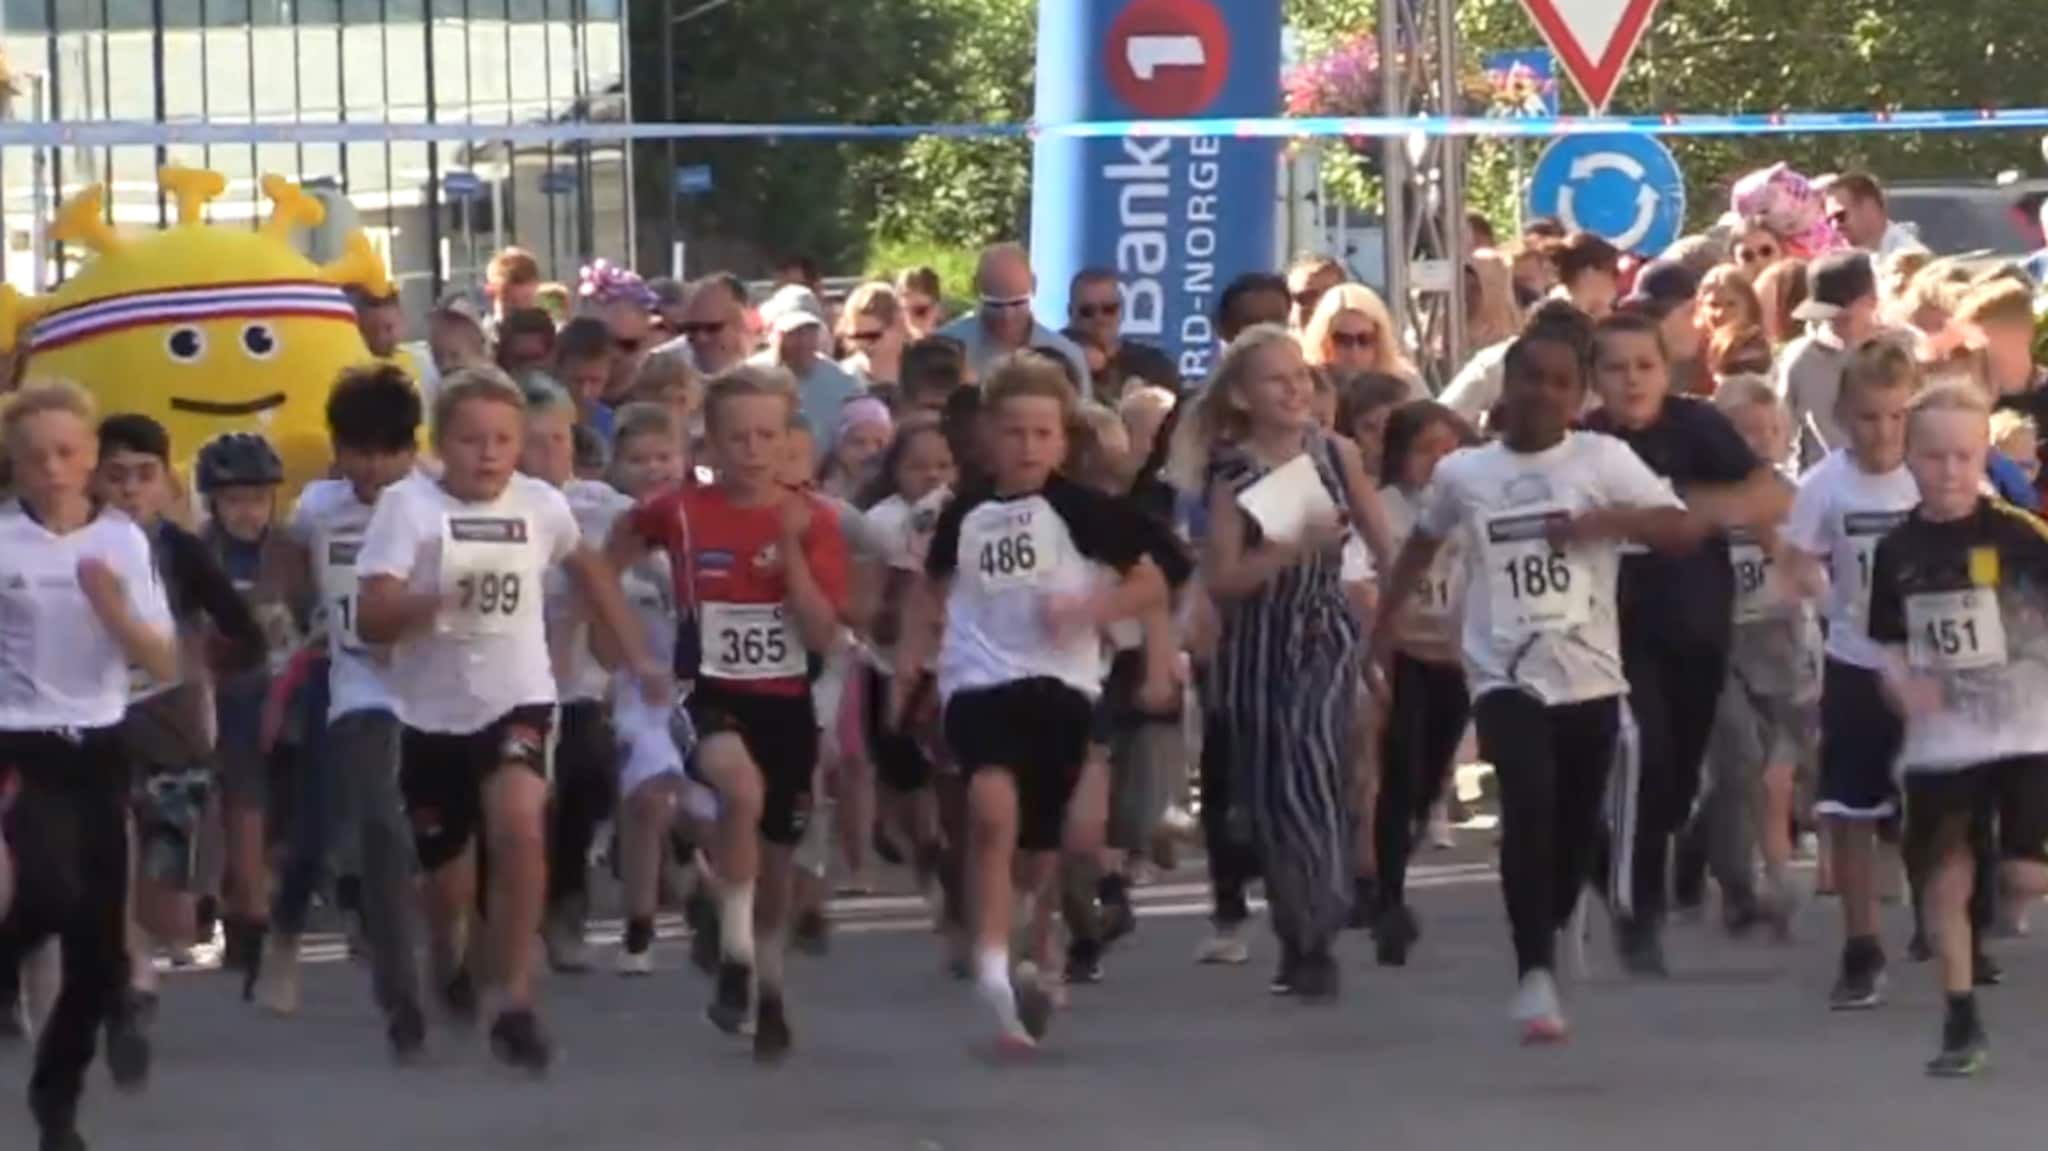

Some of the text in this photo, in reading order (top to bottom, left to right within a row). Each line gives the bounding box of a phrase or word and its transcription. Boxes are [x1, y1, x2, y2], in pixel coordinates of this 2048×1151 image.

[1126, 35, 1206, 80] 1
[1179, 137, 1219, 376] RD-NORGE
[979, 532, 1036, 577] 486
[1504, 551, 1571, 598] 186
[721, 627, 786, 664] 365
